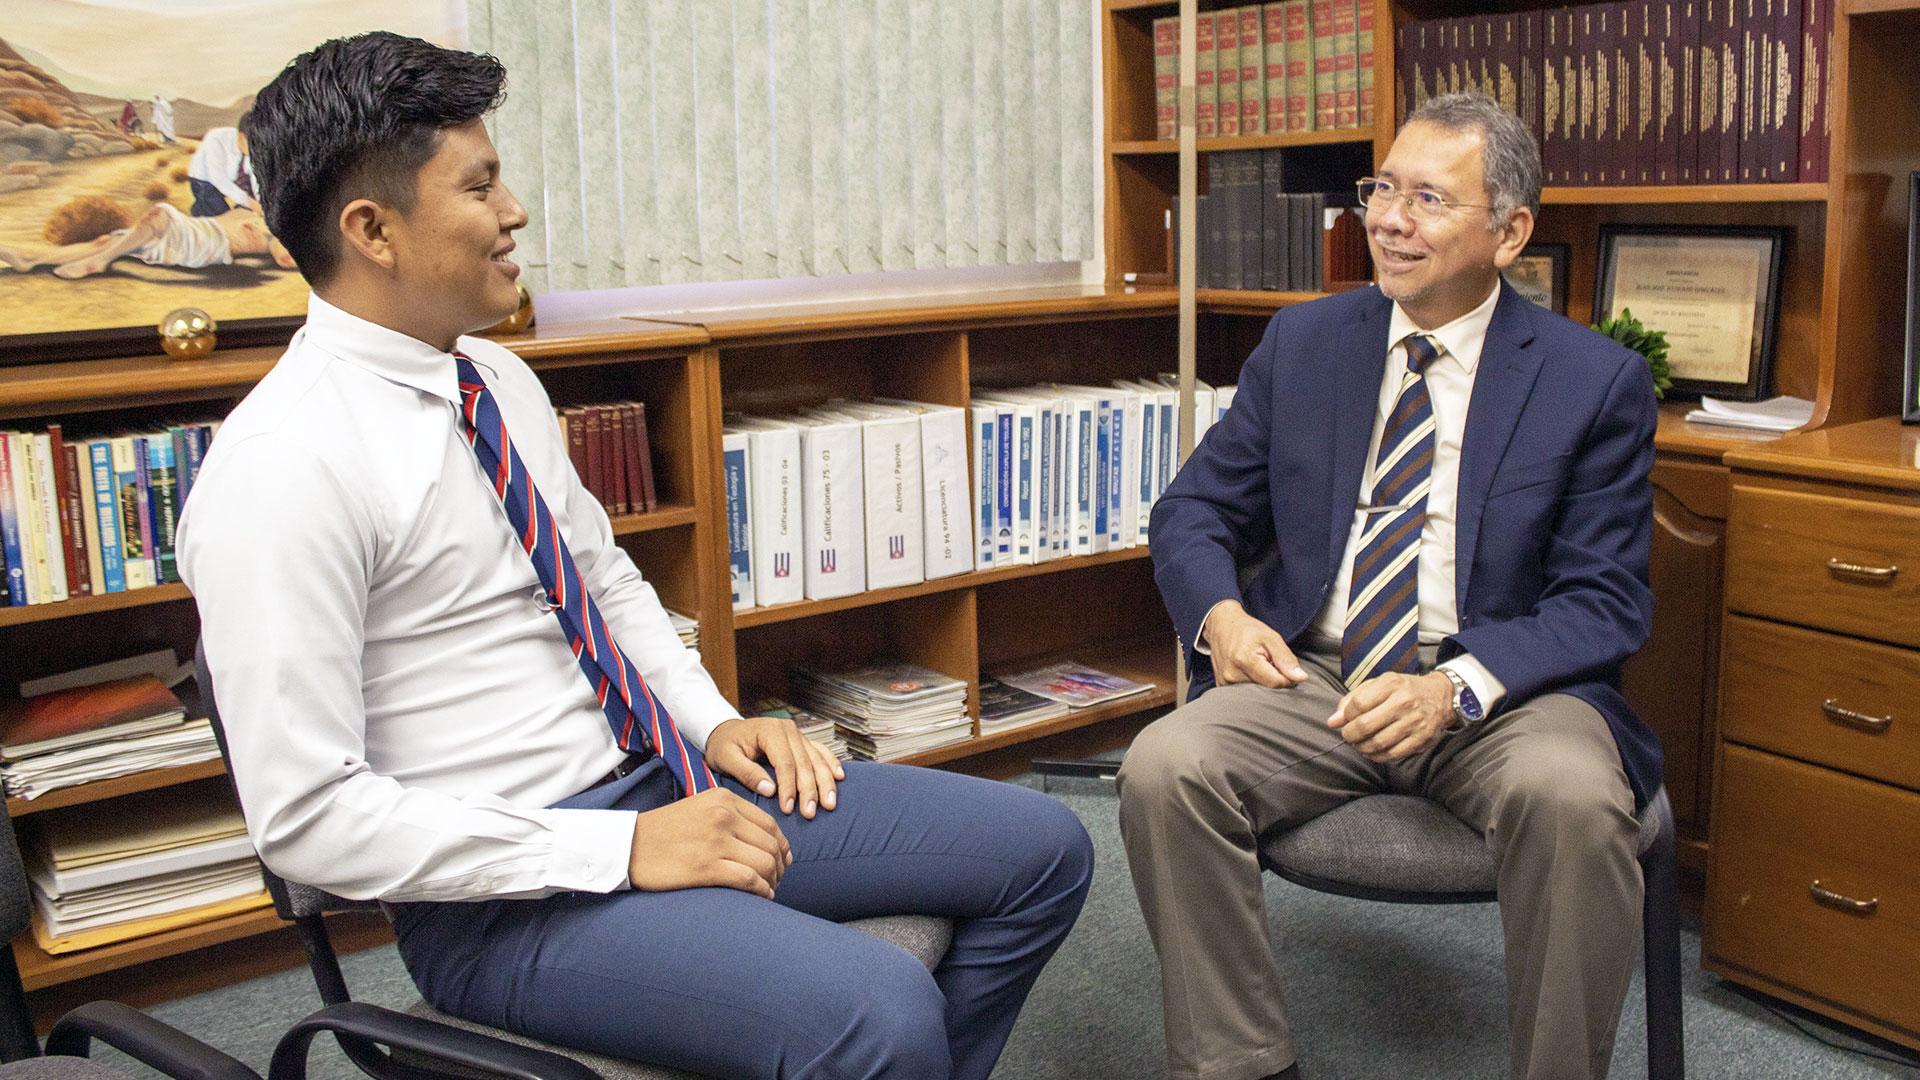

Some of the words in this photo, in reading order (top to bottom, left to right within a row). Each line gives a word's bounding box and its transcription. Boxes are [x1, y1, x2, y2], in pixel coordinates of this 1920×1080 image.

[1004, 441, 1009, 449] DE
[1022, 442, 1030, 460] March
[94, 446, 106, 464] THE
[823, 449, 830, 461] 03
[1043, 457, 1049, 465] LA
[782, 459, 788, 469] 04
[95, 466, 109, 490] FAITH
[823, 467, 830, 481] 75
[1043, 467, 1049, 476] DE
[1082, 468, 1088, 476] en
[781, 475, 788, 485] 03
[98, 493, 111, 504] OF
[895, 484, 903, 513] Activos
[732, 502, 738, 511] en
[780, 487, 788, 536] Calificaciones
[823, 482, 832, 542] Calificaciones
[939, 480, 949, 531] Licenciatura
[944, 533, 951, 544] 94
[98, 507, 116, 546] MILLIONS
[732, 512, 740, 553] Licenciatura
